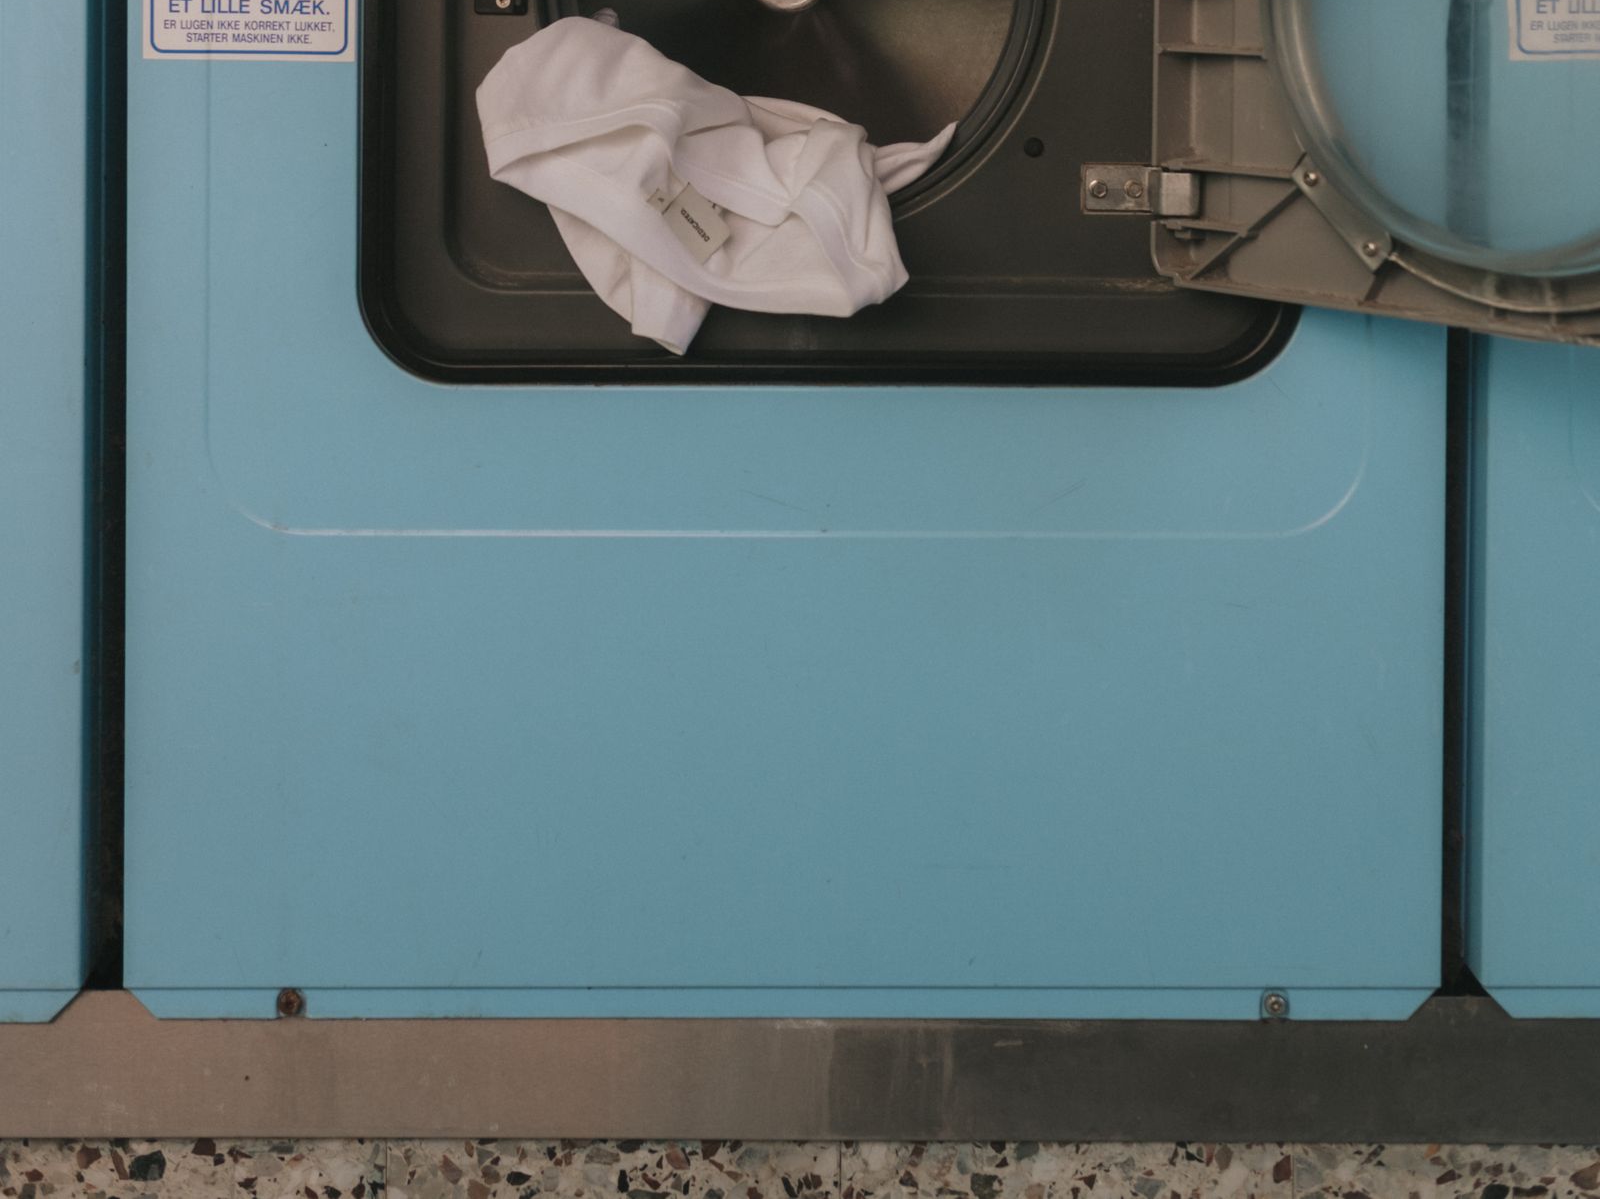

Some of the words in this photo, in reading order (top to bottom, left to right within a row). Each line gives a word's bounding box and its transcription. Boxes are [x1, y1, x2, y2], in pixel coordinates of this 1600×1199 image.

[259, 0, 331, 16] SMÆK.
[163, 19, 177, 30] ER
[180, 19, 214, 31] LUGEN
[217, 20, 240, 31] IKKE
[244, 20, 292, 32] KORREKT
[1530, 20, 1544, 31] ER
[186, 32, 229, 44] STARTER
[232, 32, 284, 44] MASKINEN
[287, 33, 313, 45] IKKE.
